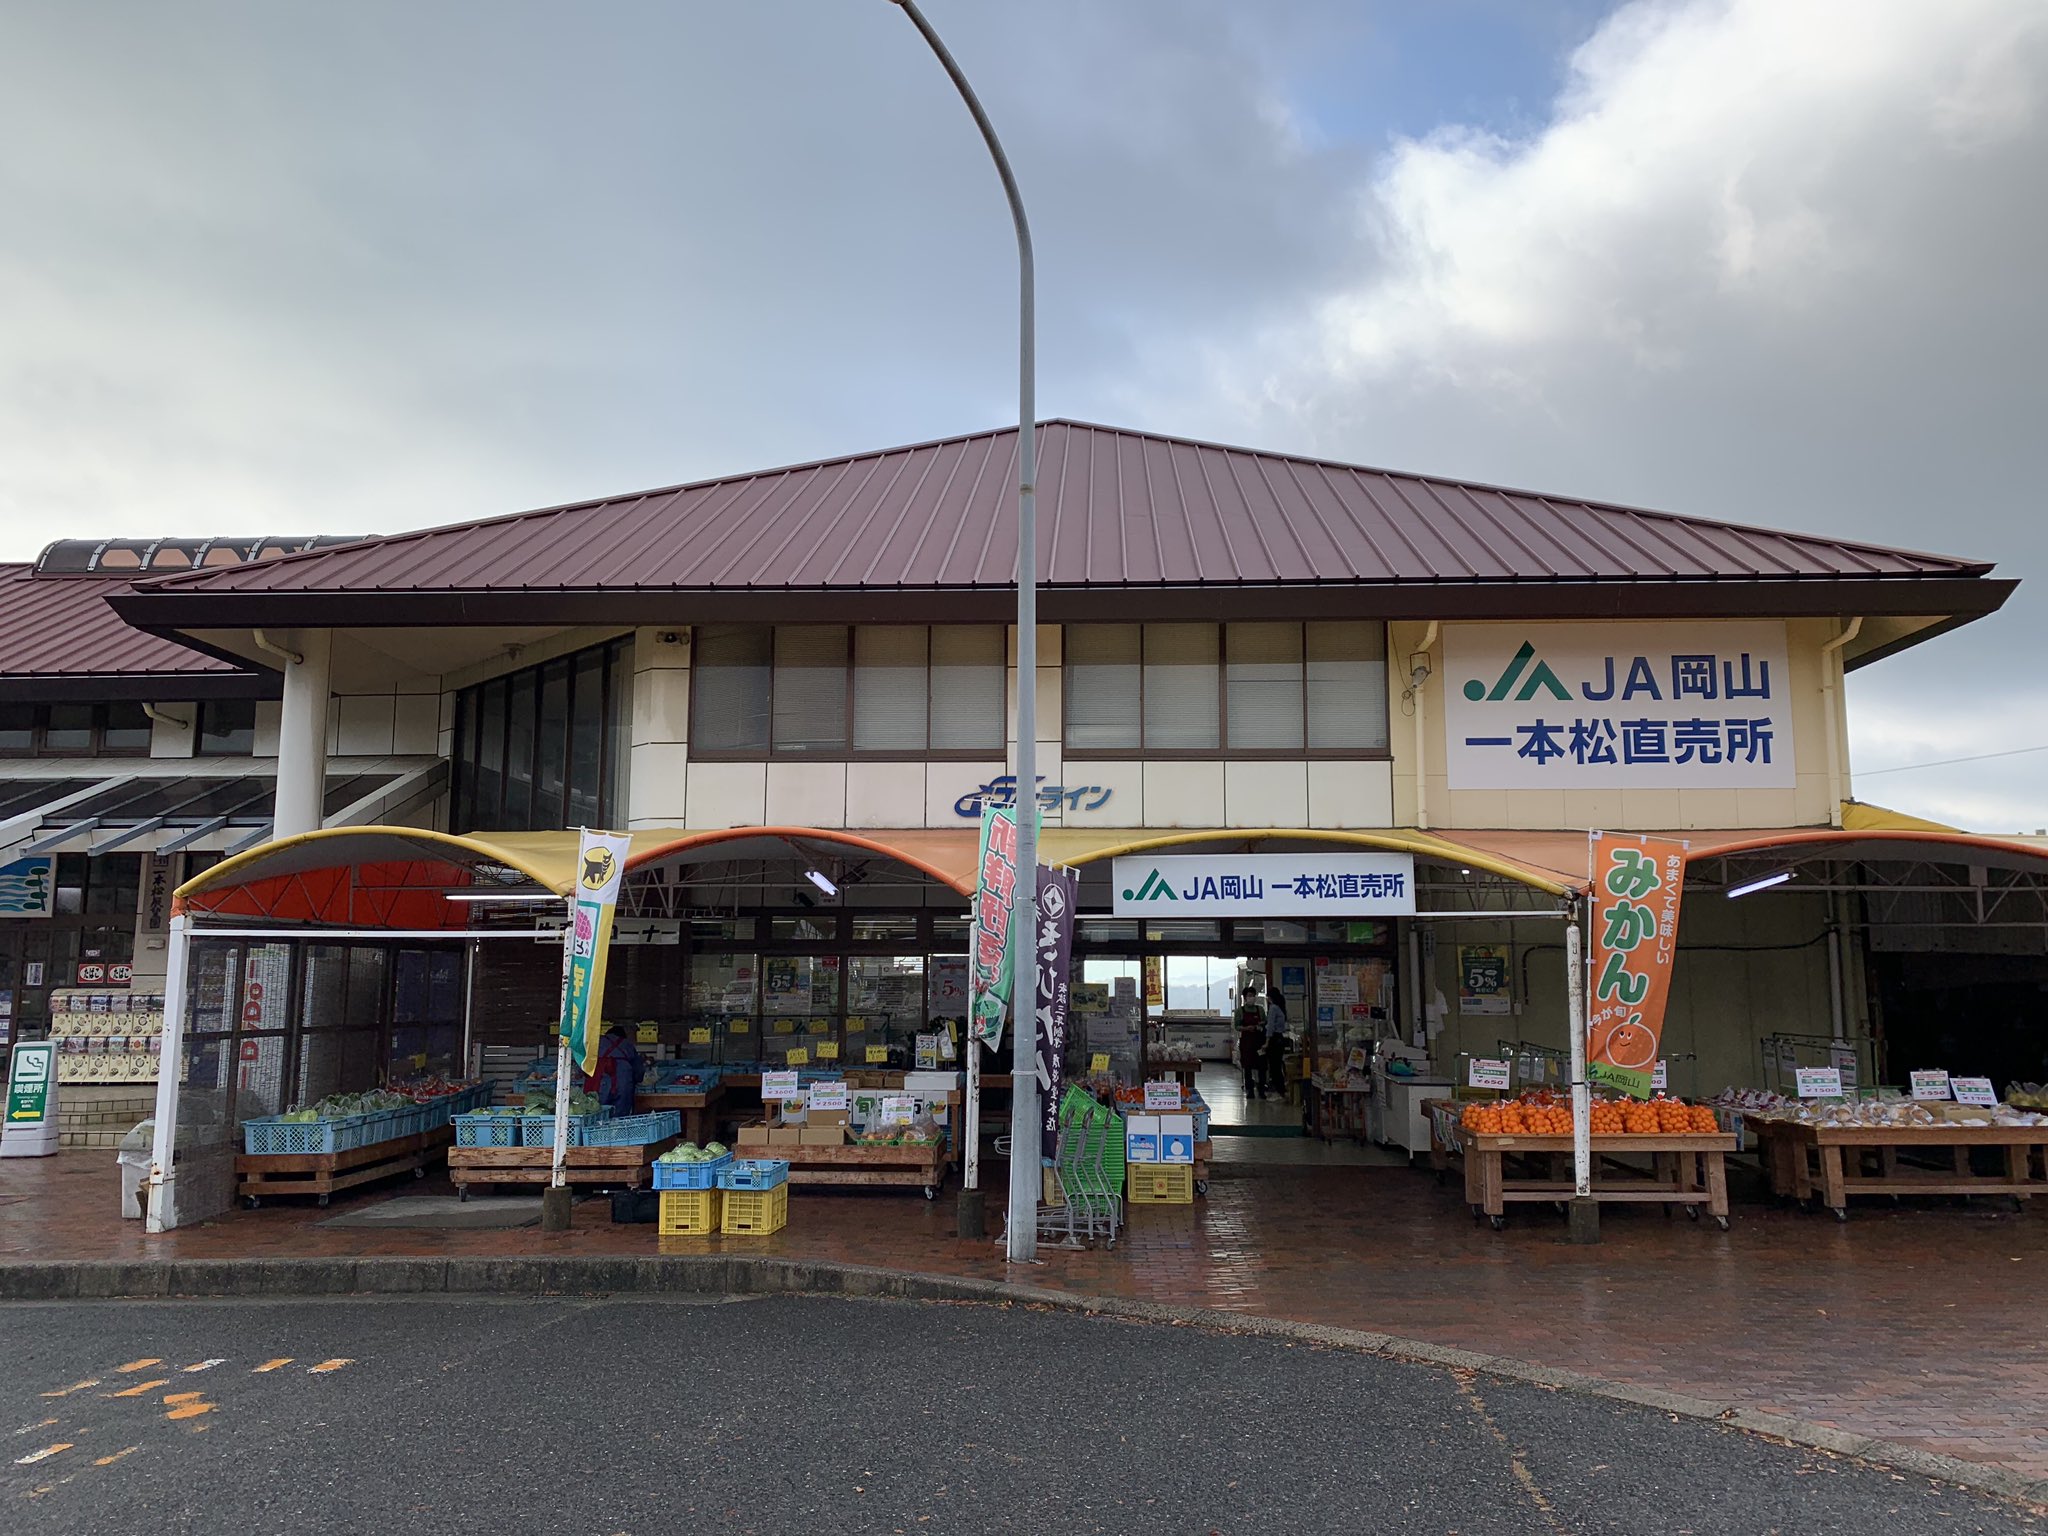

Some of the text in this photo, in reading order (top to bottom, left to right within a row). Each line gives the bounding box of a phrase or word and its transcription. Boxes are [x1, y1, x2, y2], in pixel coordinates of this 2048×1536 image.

[1581, 652, 1771, 701] JA岡山
[1465, 716, 1774, 766] 一本松直売所
[1183, 874, 1263, 901] JA岡山
[1271, 872, 1405, 900] 一本松直売所
[1657, 854, 1681, 965] あまくて美味しい
[1597, 848, 1661, 1006] みかん
[83, 967, 101, 979] たばこ
[112, 967, 130, 979] たばこ
[1469, 968, 1497, 988] 5%
[916, 1042, 936, 1050] レンコン
